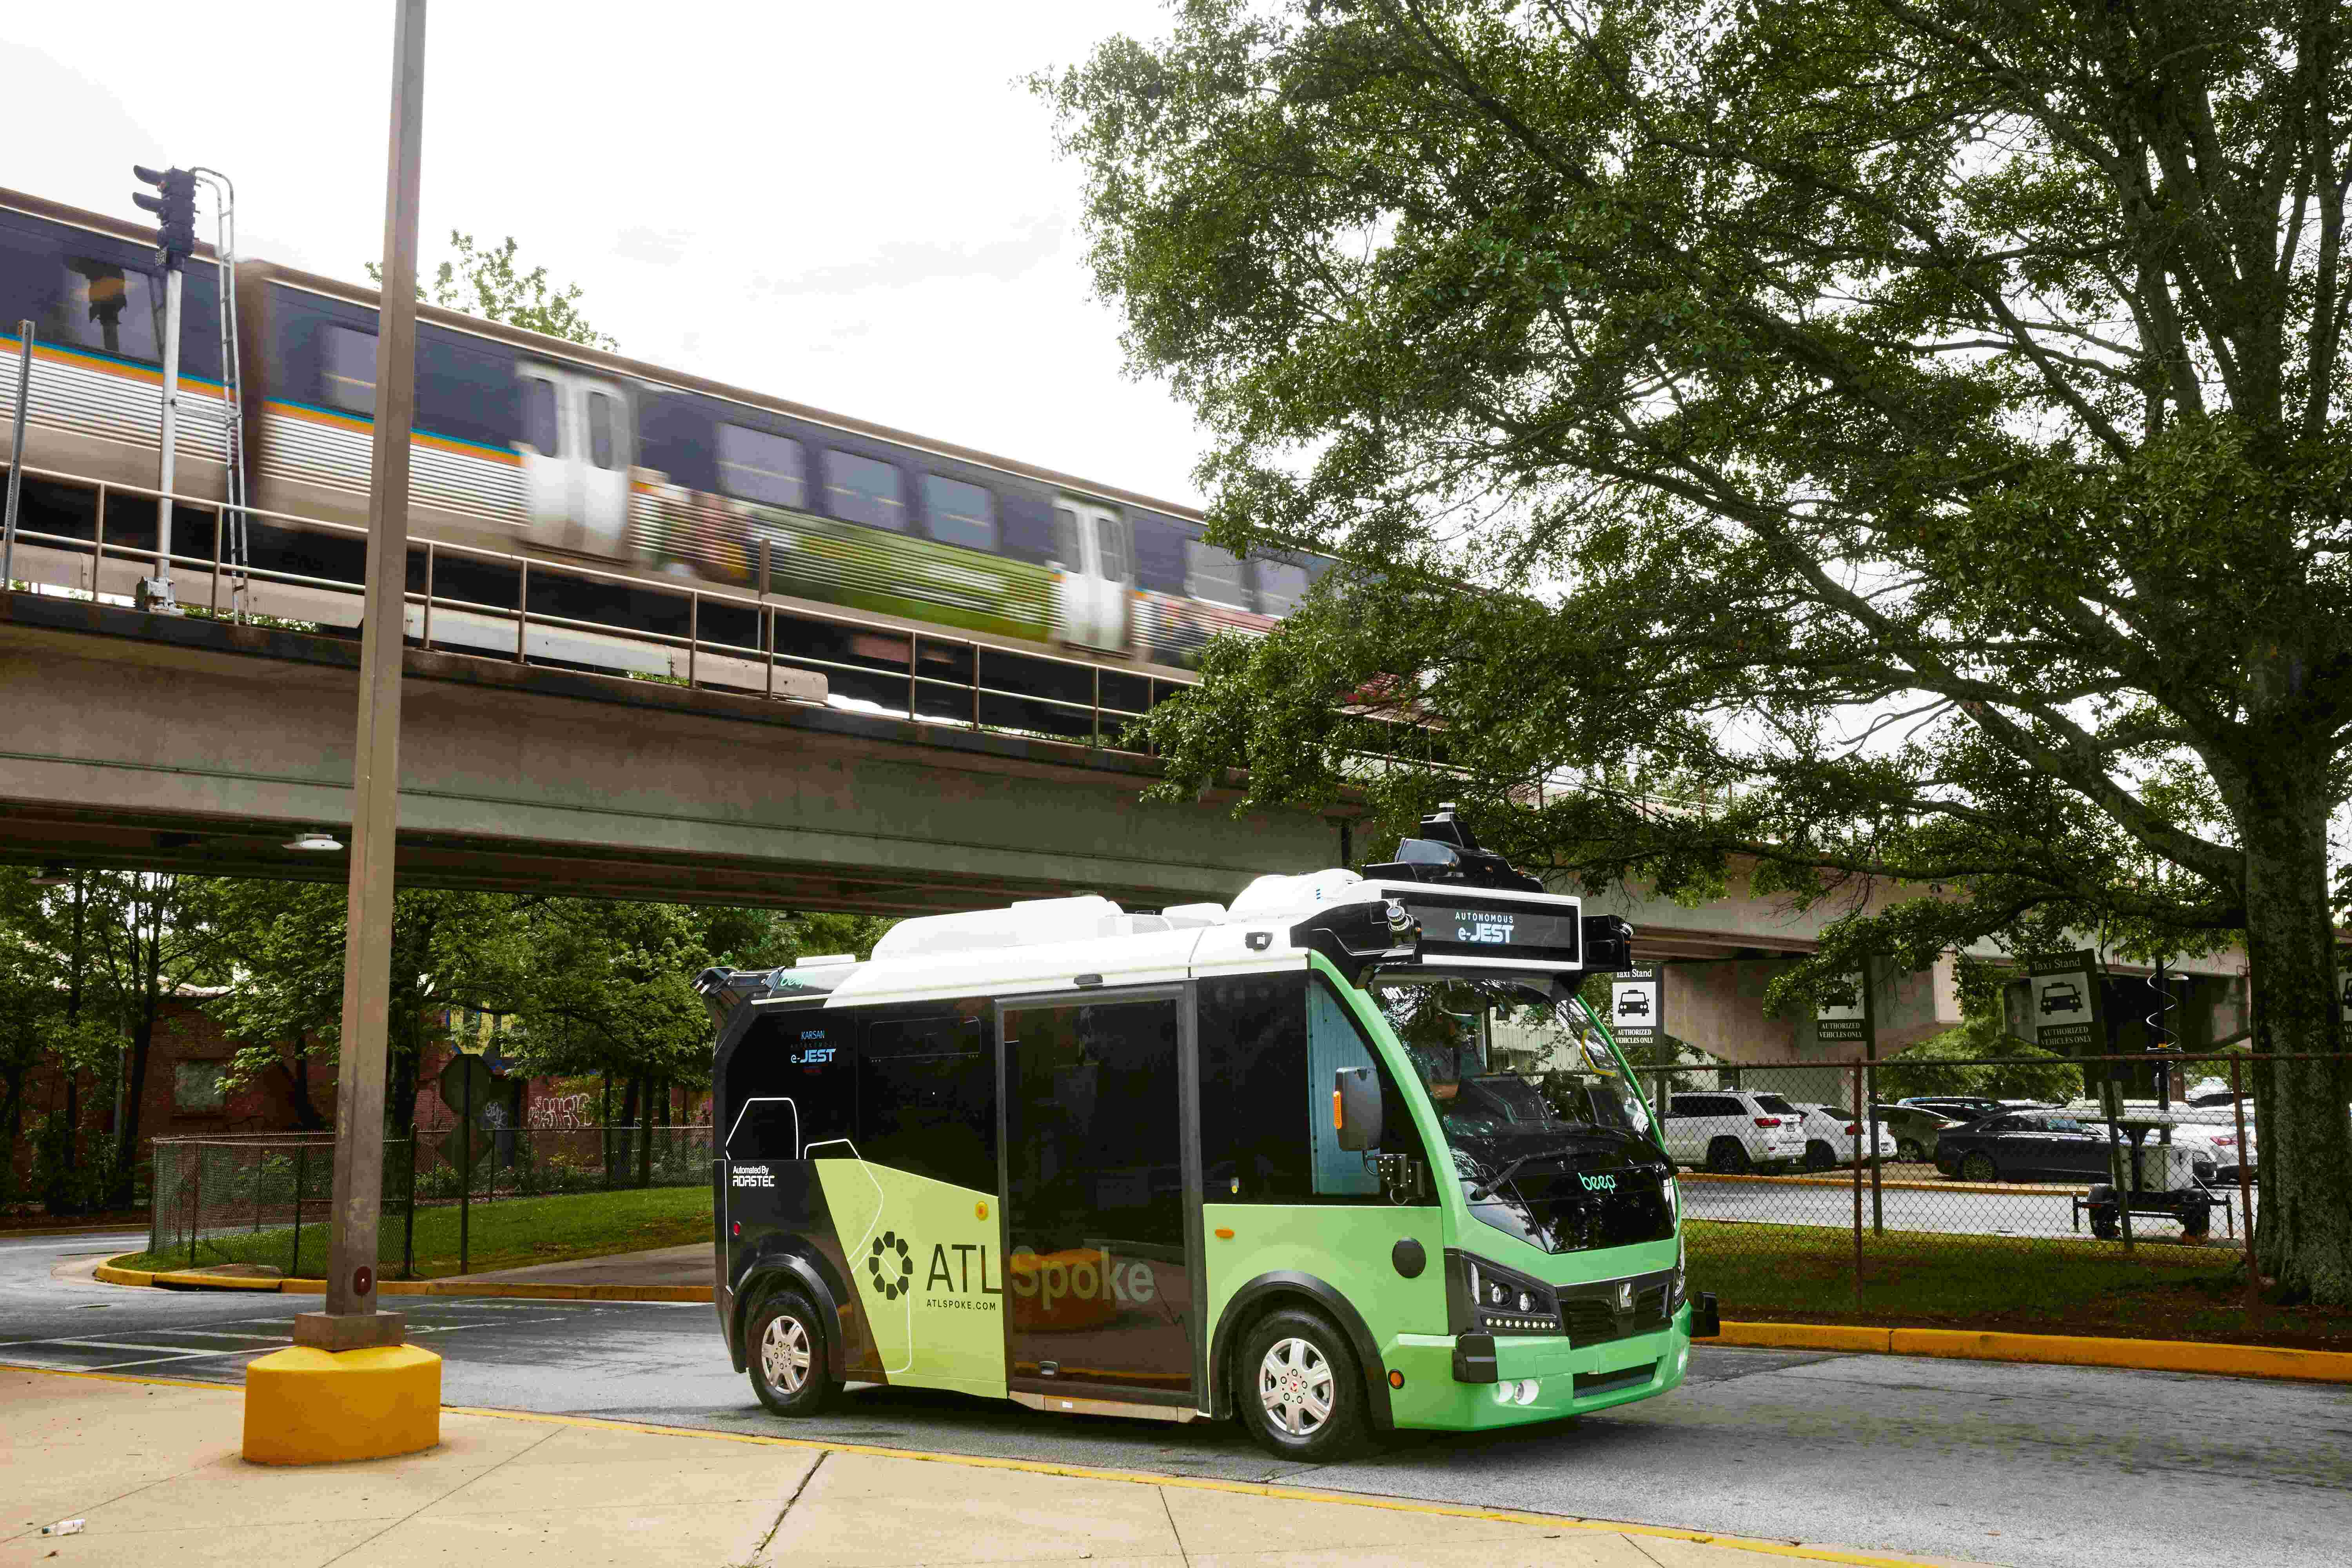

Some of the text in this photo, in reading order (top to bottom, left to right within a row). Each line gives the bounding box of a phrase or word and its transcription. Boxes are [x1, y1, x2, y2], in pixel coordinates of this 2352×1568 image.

[1455, 912, 1514, 924] AUTONOMOUS
[1458, 923, 1514, 943] e-JEST
[2032, 956, 2080, 971] Taxi Stand
[1632, 969, 1653, 977] Stand
[1381, 986, 1405, 1000] 001
[801, 1030, 825, 1040] KARSAN
[2043, 1026, 2089, 1036] AUTHORIZED
[2041, 1035, 2092, 1045] VEHICLES ONLY
[791, 1048, 836, 1063] e-JEST
[733, 1165, 769, 1175] Automated By
[733, 1175, 775, 1187] ADASTEC
[1577, 1172, 1615, 1194] beep
[926, 1243, 1154, 1310] ATL Spoke
[926, 1299, 996, 1310] ATLSPOKE.COM
